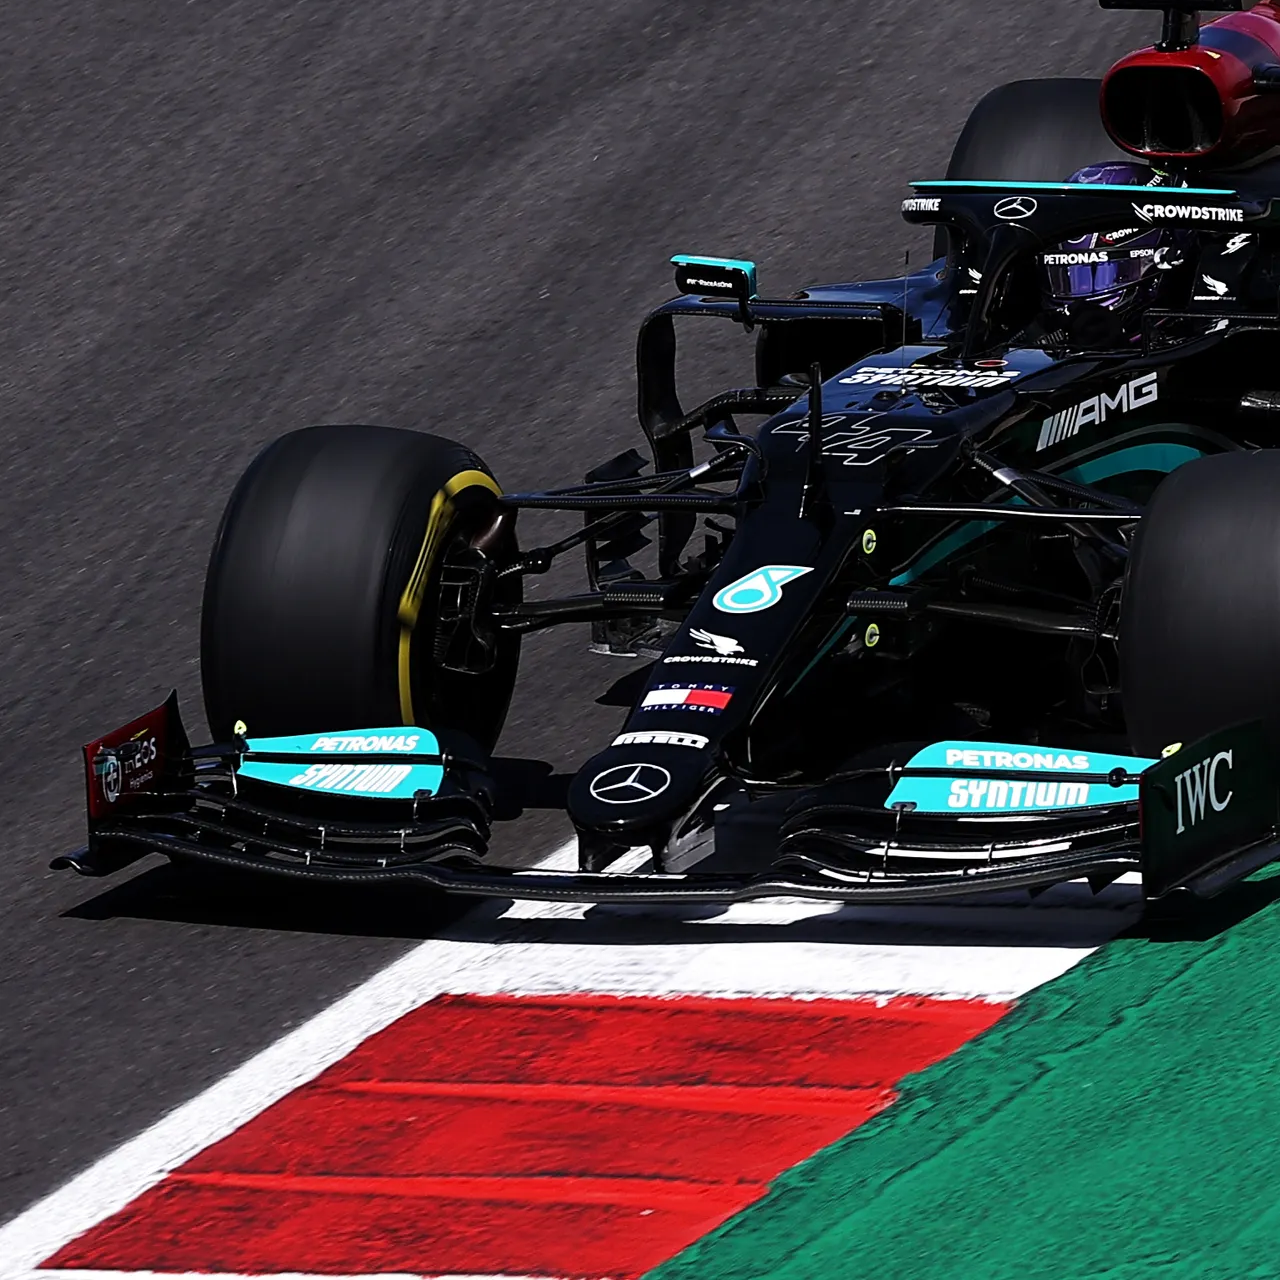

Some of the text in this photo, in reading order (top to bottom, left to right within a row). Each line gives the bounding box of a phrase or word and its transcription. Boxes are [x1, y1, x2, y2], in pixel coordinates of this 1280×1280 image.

[1142, 204, 1244, 222] CROWDSTRIKE
[1044, 252, 1109, 265] PETRONAS
[1130, 249, 1154, 258] EPSON
[856, 367, 1021, 378] PETRONAS
[838, 373, 1012, 388] SYNTIUM
[663, 656, 759, 667] CROWDSTRIKE
[658, 683, 729, 692] TOMMY
[643, 704, 715, 713] HILFIGER
[310, 735, 420, 751] PETRONAS
[611, 730, 710, 749] PIRELLI
[946, 749, 1090, 770] PETRONAS
[289, 764, 413, 793] SYNTIUM
[947, 778, 1091, 809] SYNTIUM
[1174, 749, 1233, 835] IWC
